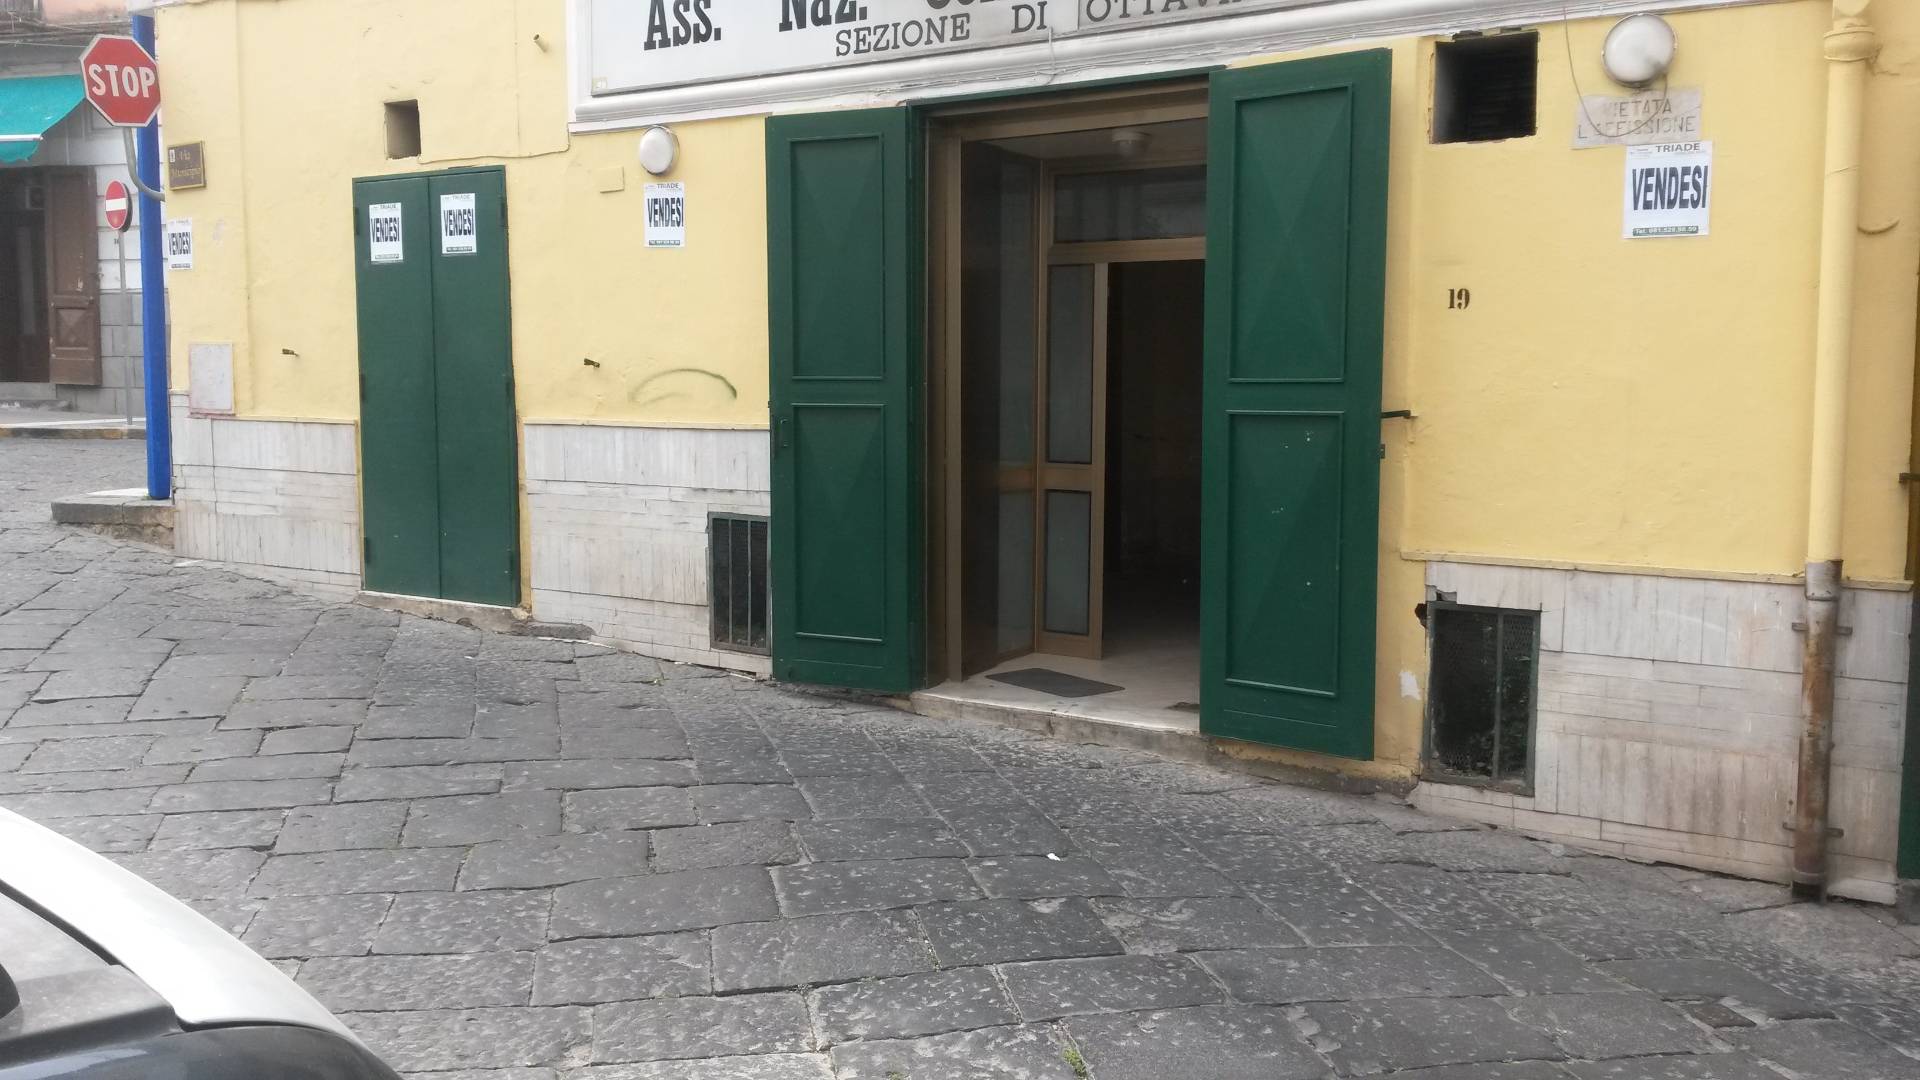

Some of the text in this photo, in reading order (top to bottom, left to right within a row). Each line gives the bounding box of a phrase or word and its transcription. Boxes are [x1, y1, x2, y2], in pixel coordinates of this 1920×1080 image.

[836, 13, 970, 56] SEZIONE
[1011, 1, 1048, 33] DI
[88, 63, 155, 98] STOP
[1655, 143, 1701, 153] TRIADE
[1632, 165, 1708, 211] VENDESI
[443, 208, 474, 236] VENDESI
[647, 197, 684, 227] VENDESI
[168, 232, 191, 255] VENDESI
[370, 217, 400, 243] VENDESI
[1448, 288, 1470, 310] 19
